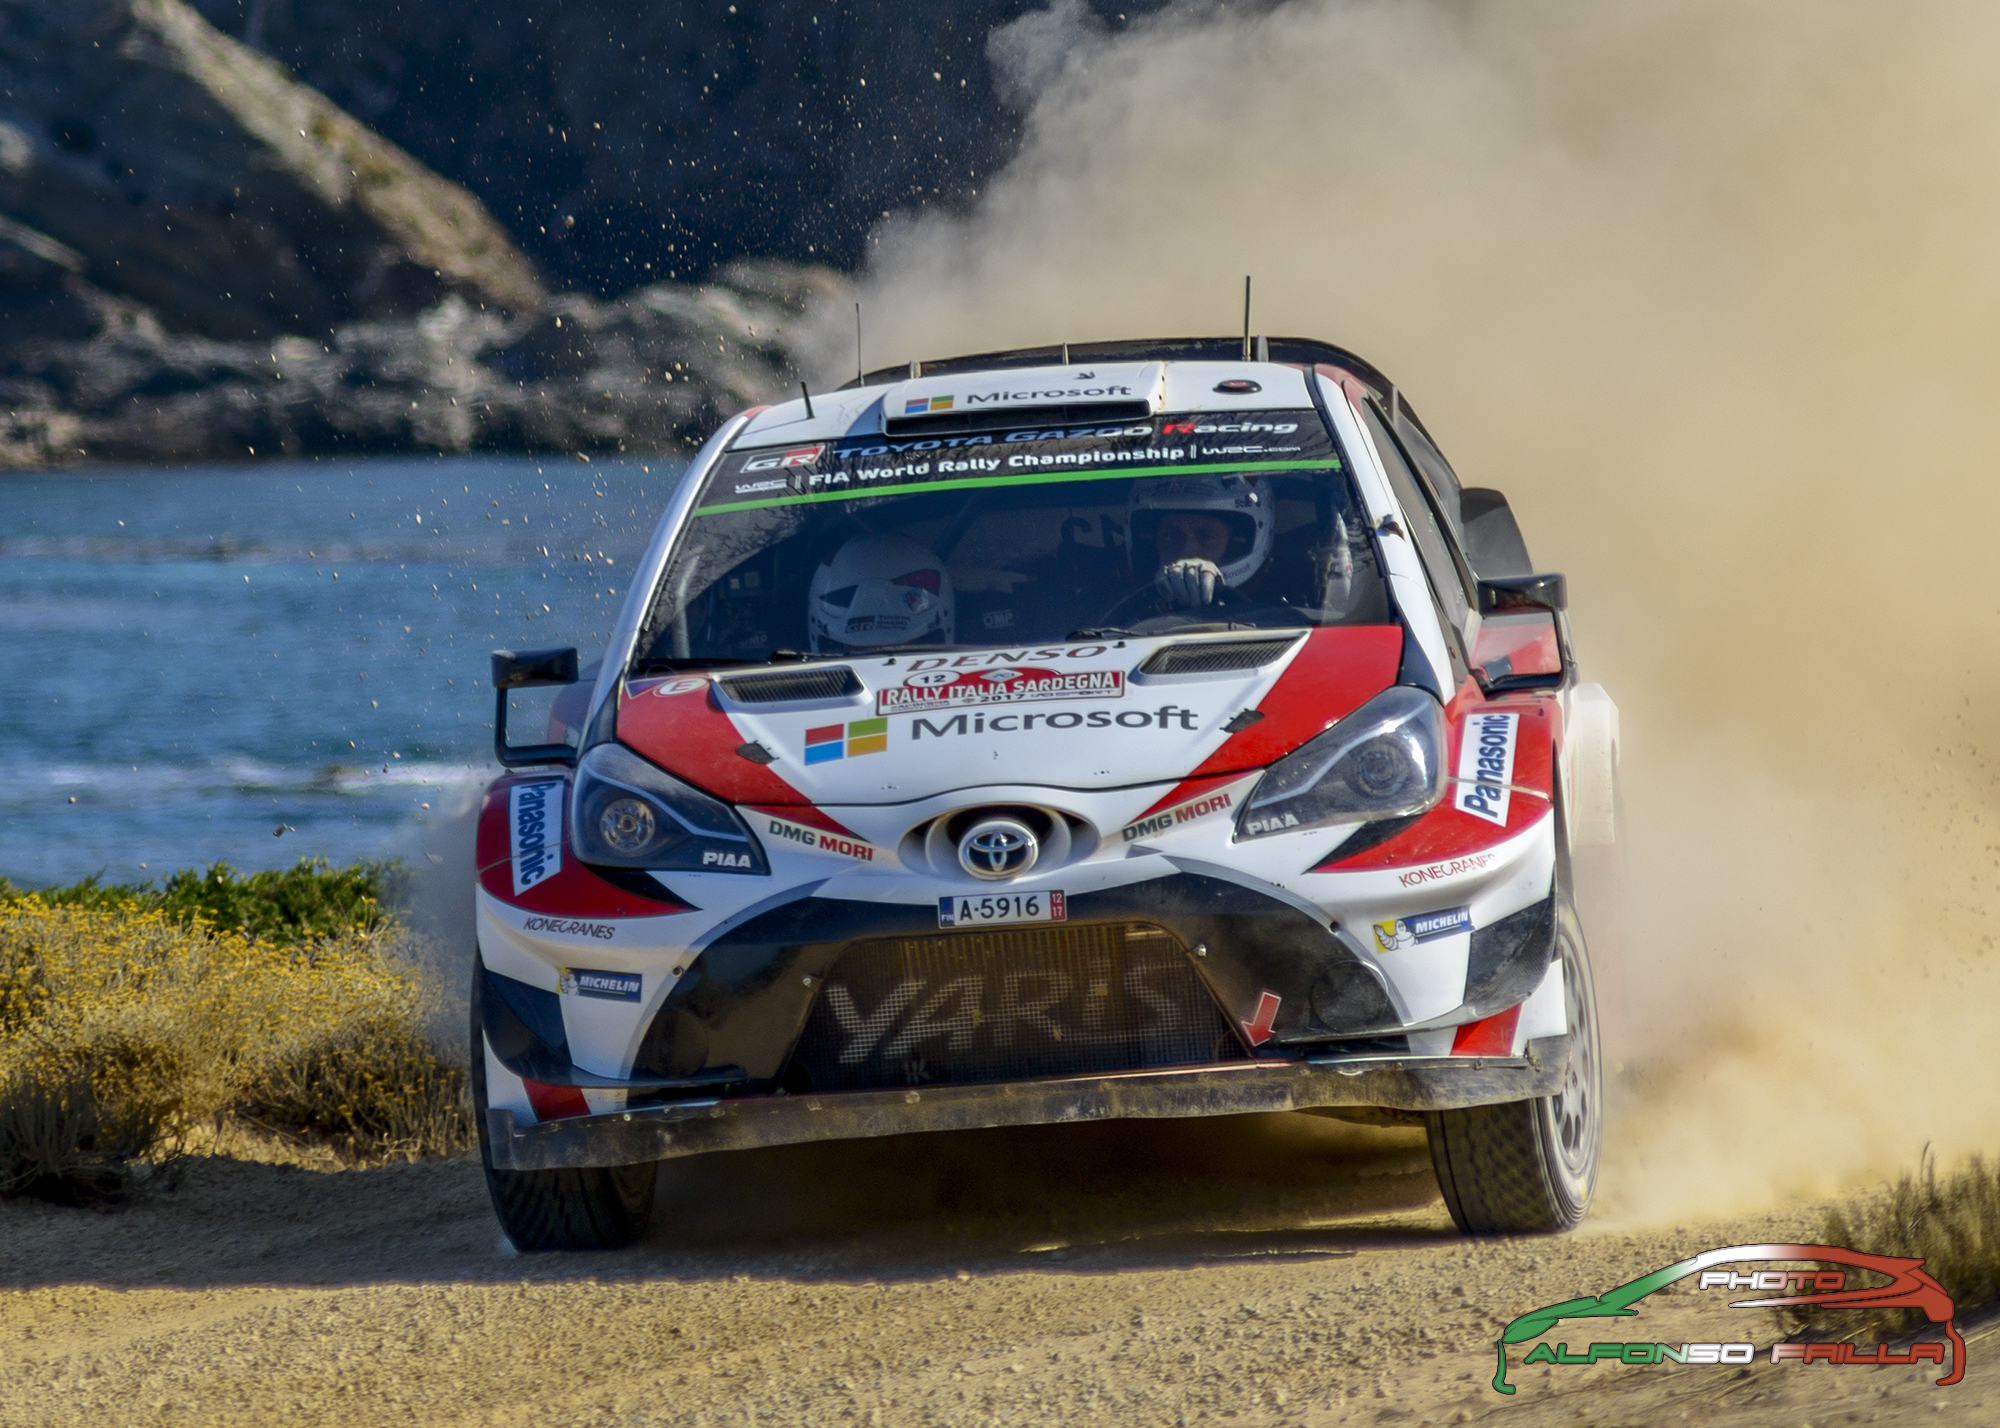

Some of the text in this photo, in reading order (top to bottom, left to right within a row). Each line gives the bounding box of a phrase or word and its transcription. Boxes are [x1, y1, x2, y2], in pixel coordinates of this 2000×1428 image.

[966, 383, 1132, 406] Microsoft
[834, 421, 1299, 459] TOYOTA GAZOO Racing
[743, 447, 822, 472] GR
[809, 445, 1185, 486] FIA World Rally Championship
[906, 646, 1108, 673] DENSO
[885, 687, 945, 706] RALLY
[948, 680, 1007, 698] ITALIA
[1013, 672, 1115, 694] SARDEGNA
[920, 674, 946, 685] 12
[980, 694, 1025, 704] 2017
[911, 705, 1199, 741] Microsoft
[1463, 714, 1511, 818] Panasonic
[1122, 793, 1233, 843] DMG MORI
[1246, 812, 1300, 836] PIAA
[515, 781, 556, 887] Panasonic
[768, 820, 874, 862] DMG MORI
[702, 851, 752, 869] PIAA
[1051, 892, 1063, 904] 12
[941, 913, 954, 922] FIN
[1052, 905, 1063, 917] 17
[1415, 909, 1469, 934] MICHELIN
[523, 917, 616, 940] KONECRANES
[579, 974, 640, 994] MICHELIN
[827, 959, 1187, 1064] YARIS
